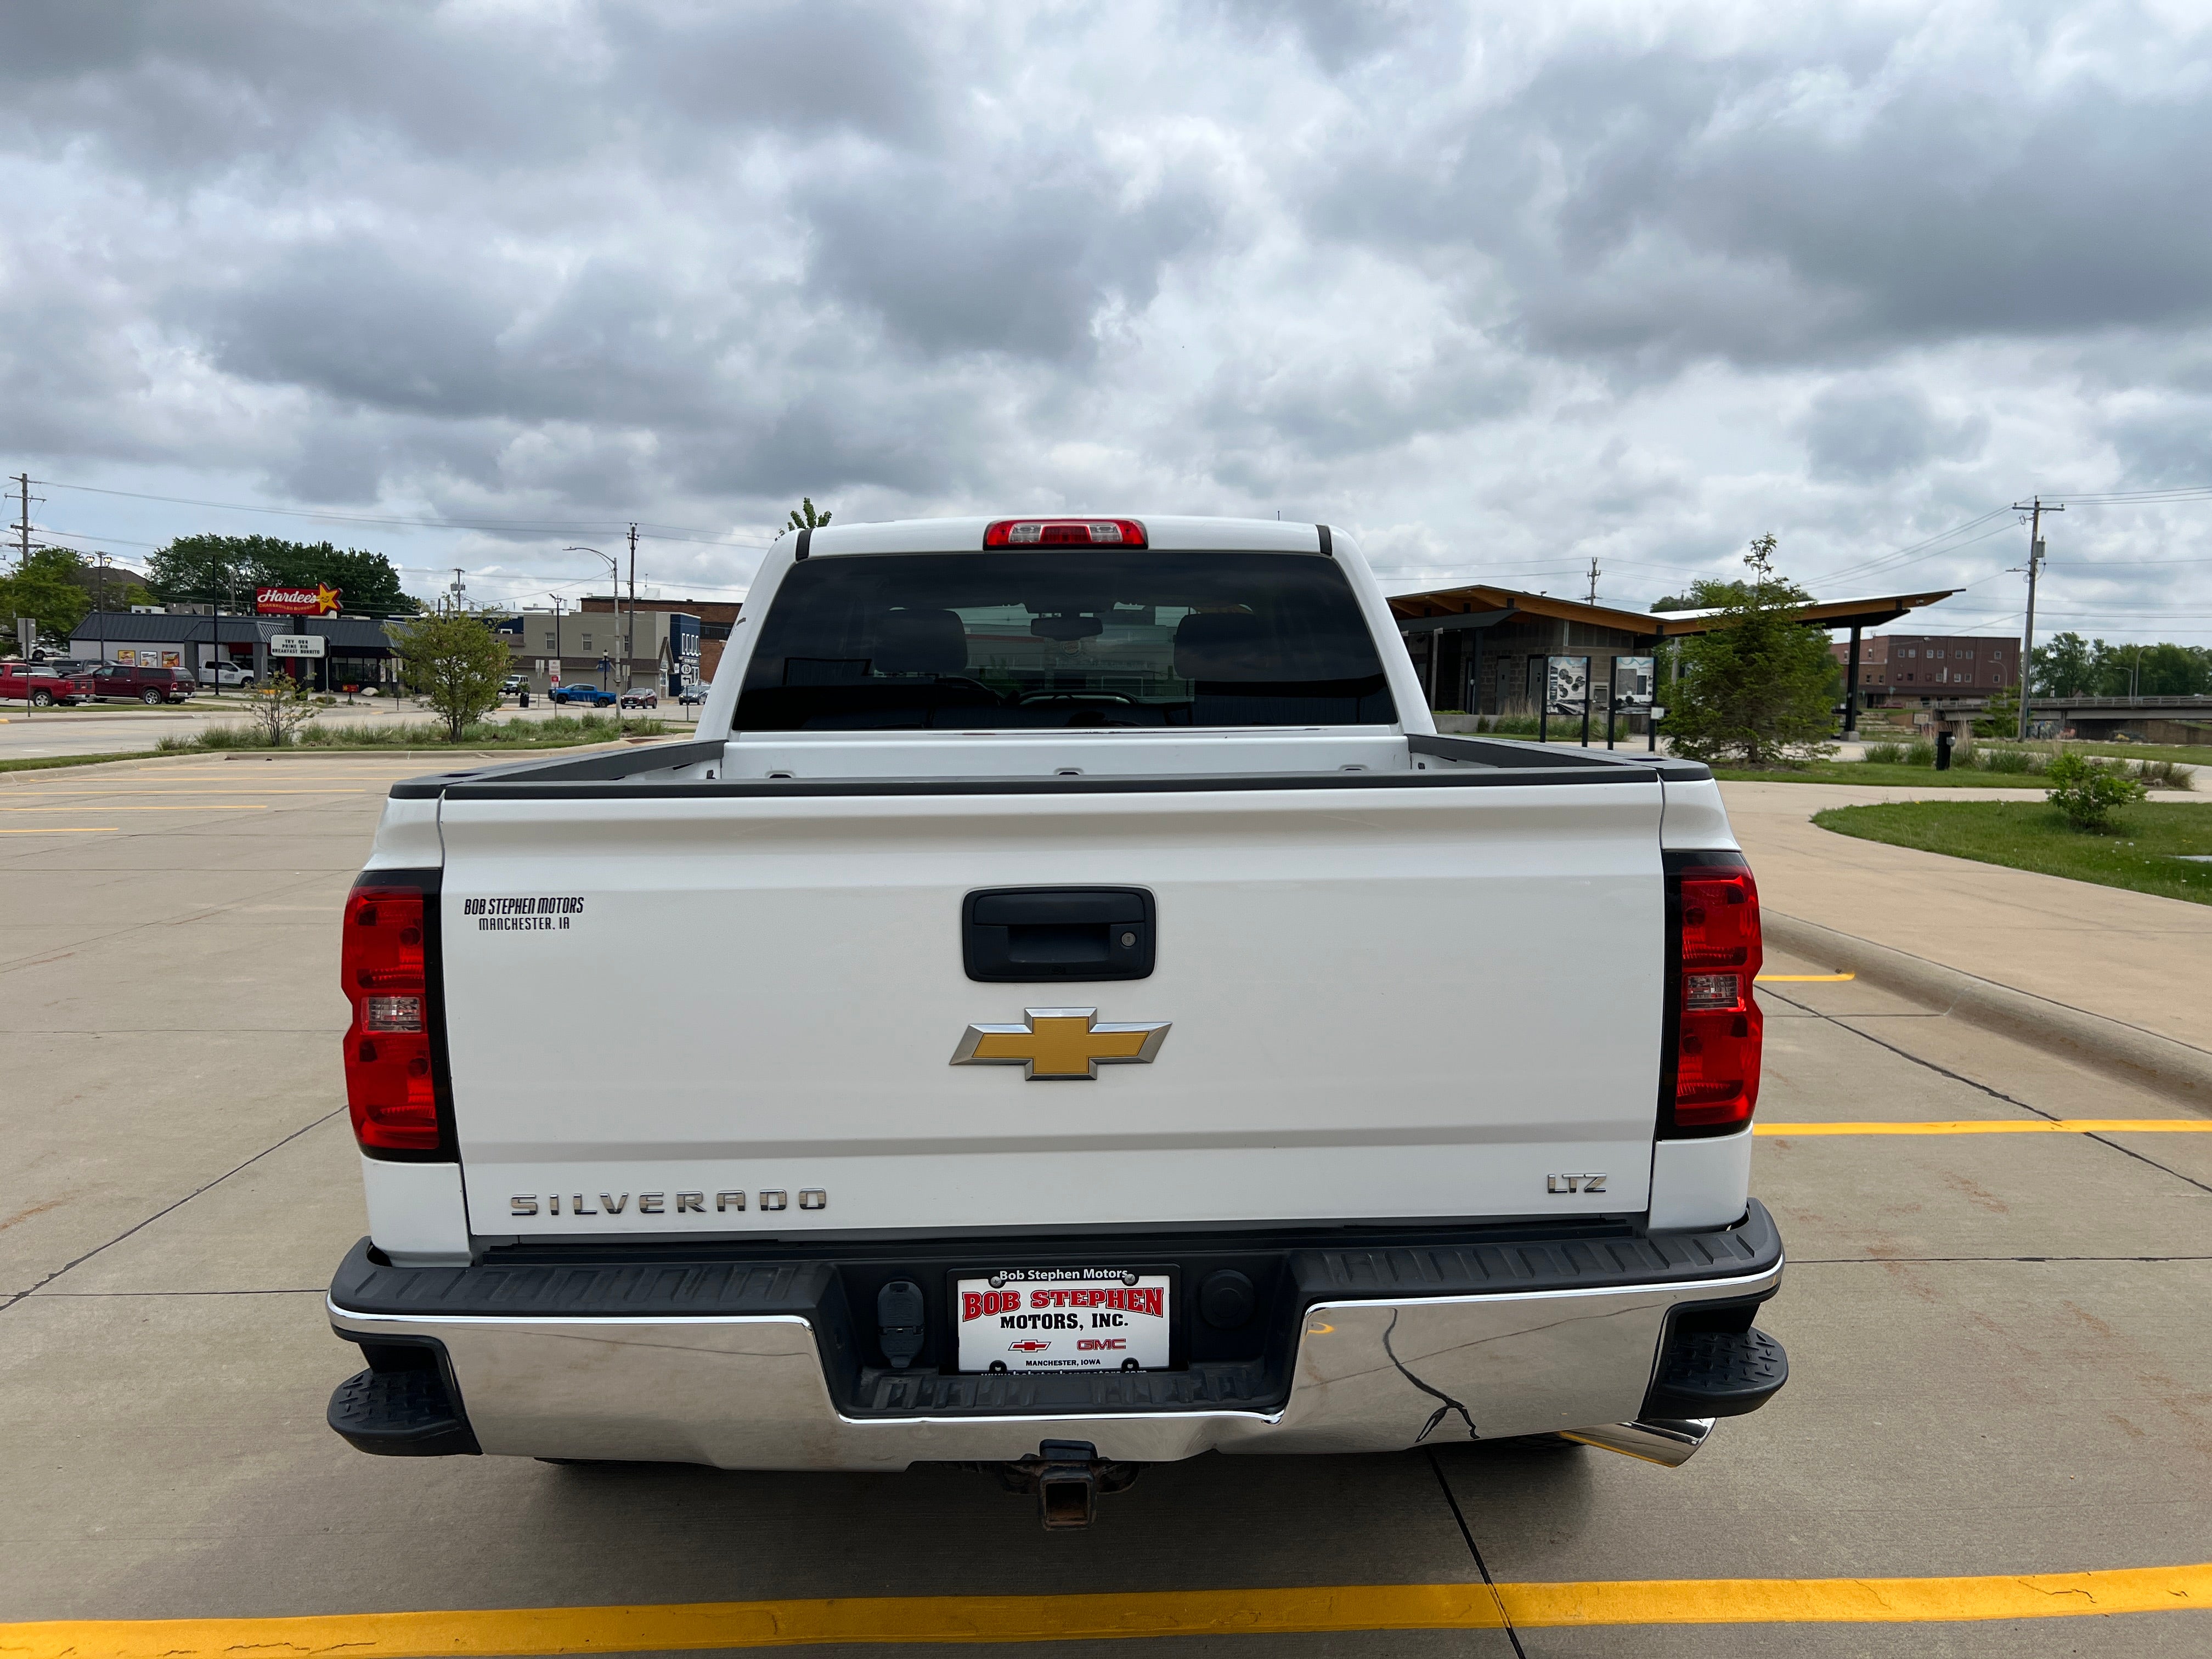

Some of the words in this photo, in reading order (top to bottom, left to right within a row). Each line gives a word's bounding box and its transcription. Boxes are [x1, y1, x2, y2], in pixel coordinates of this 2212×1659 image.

[257, 589, 320, 603] Hardee's
[464, 899, 486, 915] BOB
[488, 898, 535, 915] STEPHEN
[537, 896, 584, 913] MOTORS
[559, 917, 570, 929] IA
[1548, 1173, 1607, 1193] LTZ
[511, 1188, 826, 1216] SILVERADO
[1000, 1270, 1024, 1280] Bob
[1028, 1269, 1080, 1282] Stephen
[1083, 1268, 1127, 1279] Motors
[962, 1290, 1021, 1322] BOB
[1030, 1287, 1164, 1318] STEPHEN
[1000, 1313, 1084, 1331] MOTORS,
[1092, 1313, 1128, 1328] INC.
[1076, 1338, 1126, 1351] GMC
